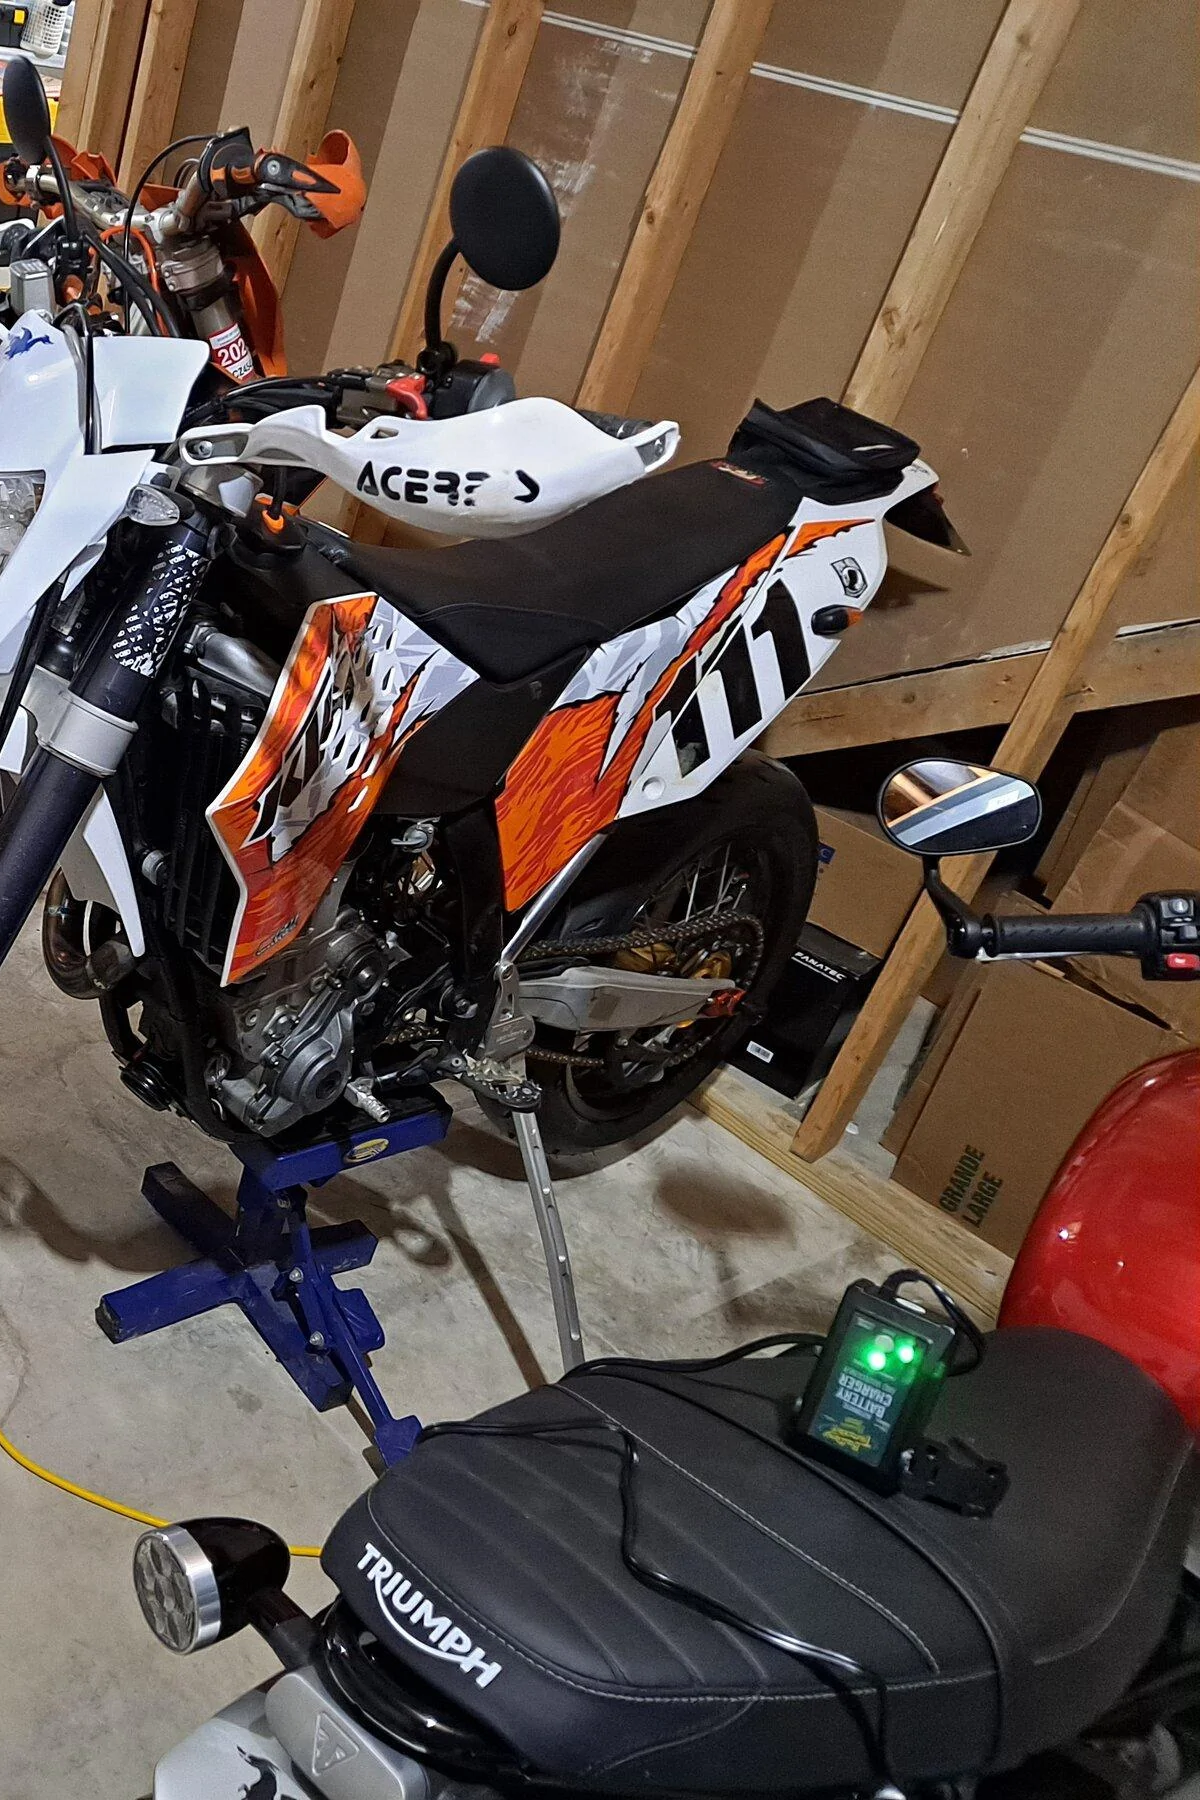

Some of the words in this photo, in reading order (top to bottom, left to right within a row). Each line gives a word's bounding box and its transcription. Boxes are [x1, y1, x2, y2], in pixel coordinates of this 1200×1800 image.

[794, 951, 848, 980] FANATEC
[939, 1144, 985, 1213] GRANDE
[962, 1171, 1003, 1229] LARGE
[835, 1386, 887, 1419] BATTERY
[838, 1373, 893, 1408] CHARGER
[357, 1542, 503, 1689] TRIUMPH
